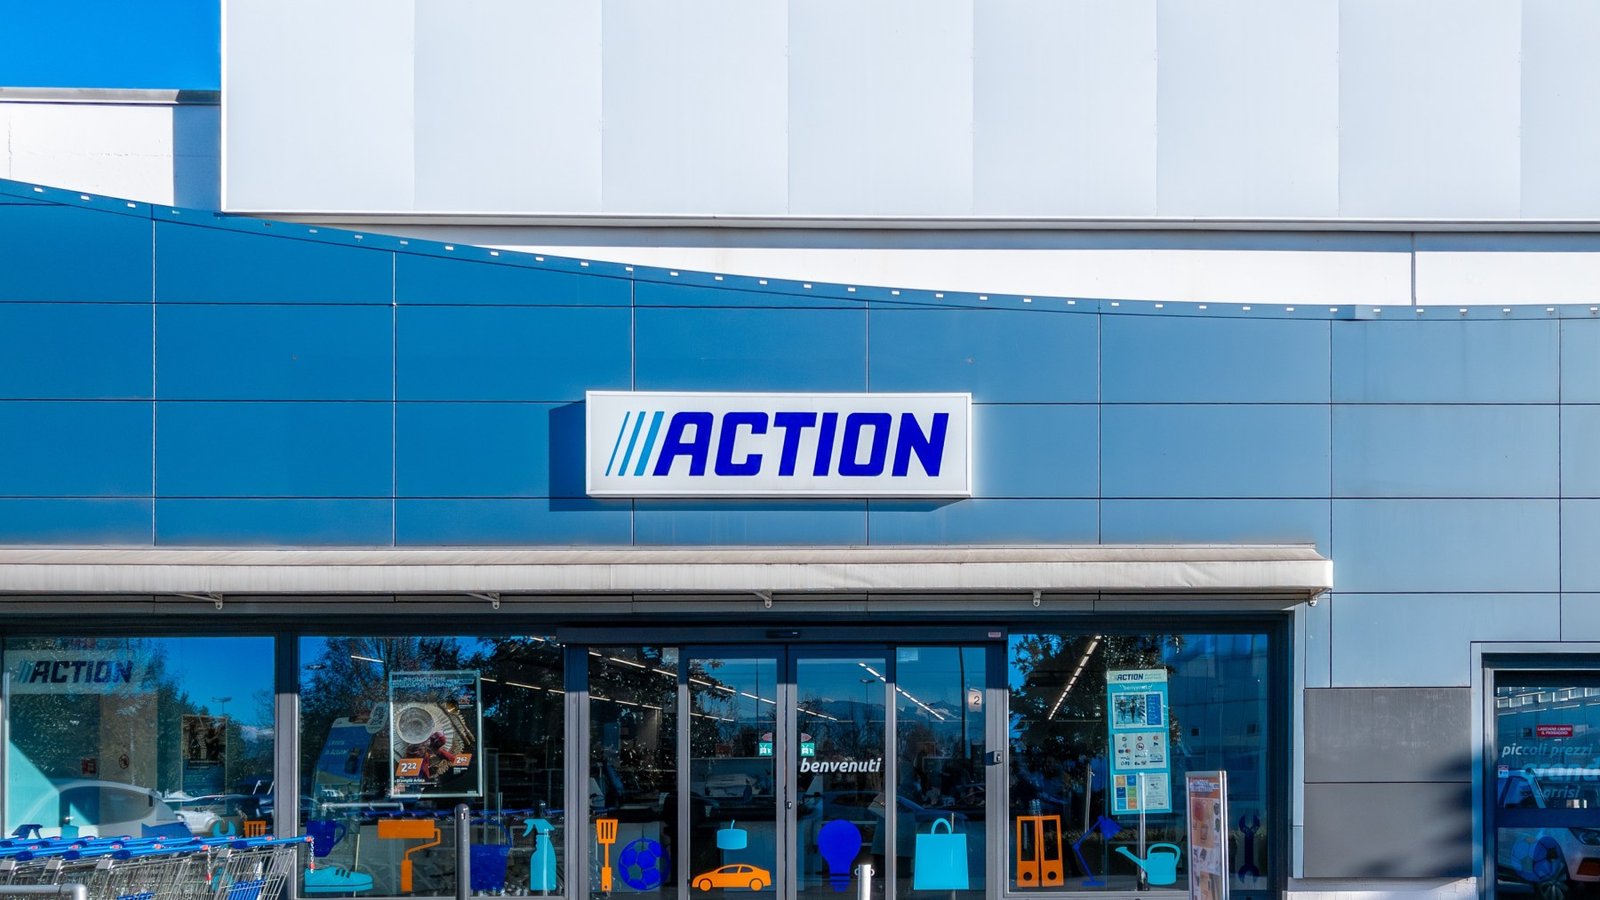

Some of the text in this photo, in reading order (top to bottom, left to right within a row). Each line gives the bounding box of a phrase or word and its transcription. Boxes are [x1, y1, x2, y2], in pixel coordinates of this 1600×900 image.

[652, 411, 949, 477] ACTION
[29, 660, 133, 683] ACTION
[1117, 673, 1144, 681] ACTION
[974, 696, 981, 705] 2
[1502, 742, 1593, 758] piccoli prezzi
[800, 758, 882, 773] benvenuti
